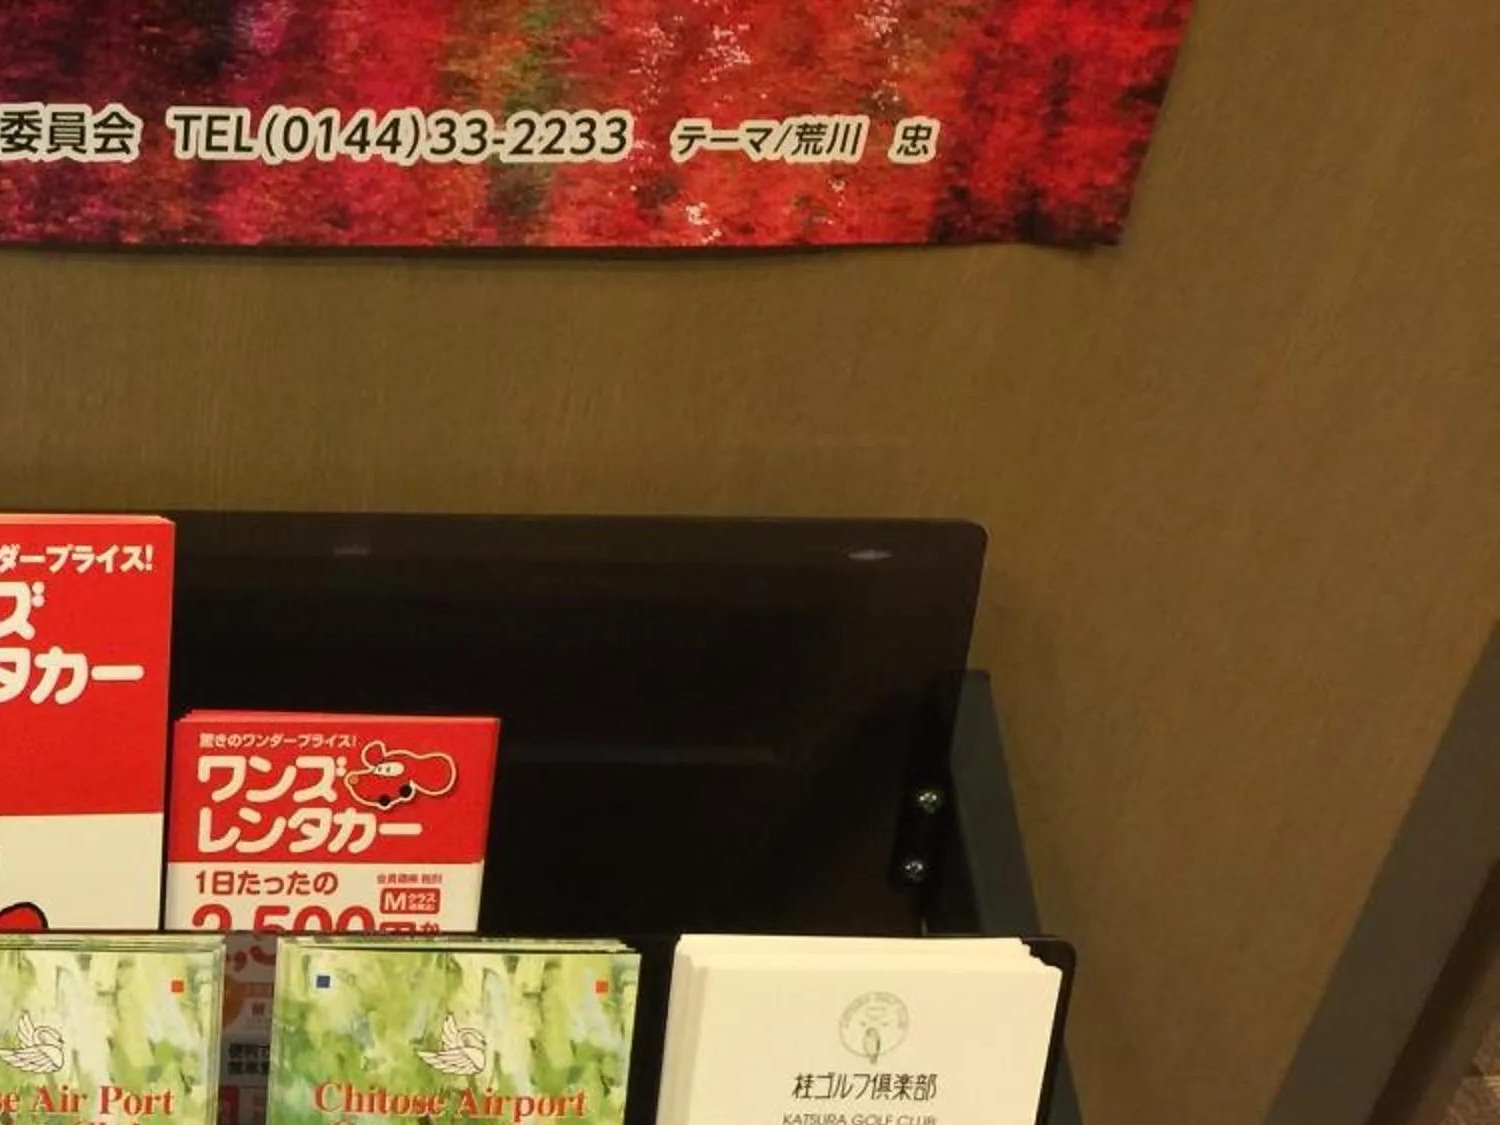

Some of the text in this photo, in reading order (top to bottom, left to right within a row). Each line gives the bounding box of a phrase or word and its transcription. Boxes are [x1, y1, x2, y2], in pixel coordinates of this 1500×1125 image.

[172, 113, 629, 157] TEL(0144)33-2233
[197, 754, 347, 803] ワンズ
[198, 806, 423, 854] レンタカー
[195, 869, 339, 896] 1日たったの
[384, 892, 406, 911] M
[32, 1084, 88, 1116] Air
[100, 1085, 178, 1117] Port
[313, 1082, 589, 1123] Chitose Airport
[791, 1072, 938, 1101] 桂ゴルフ倶楽部
